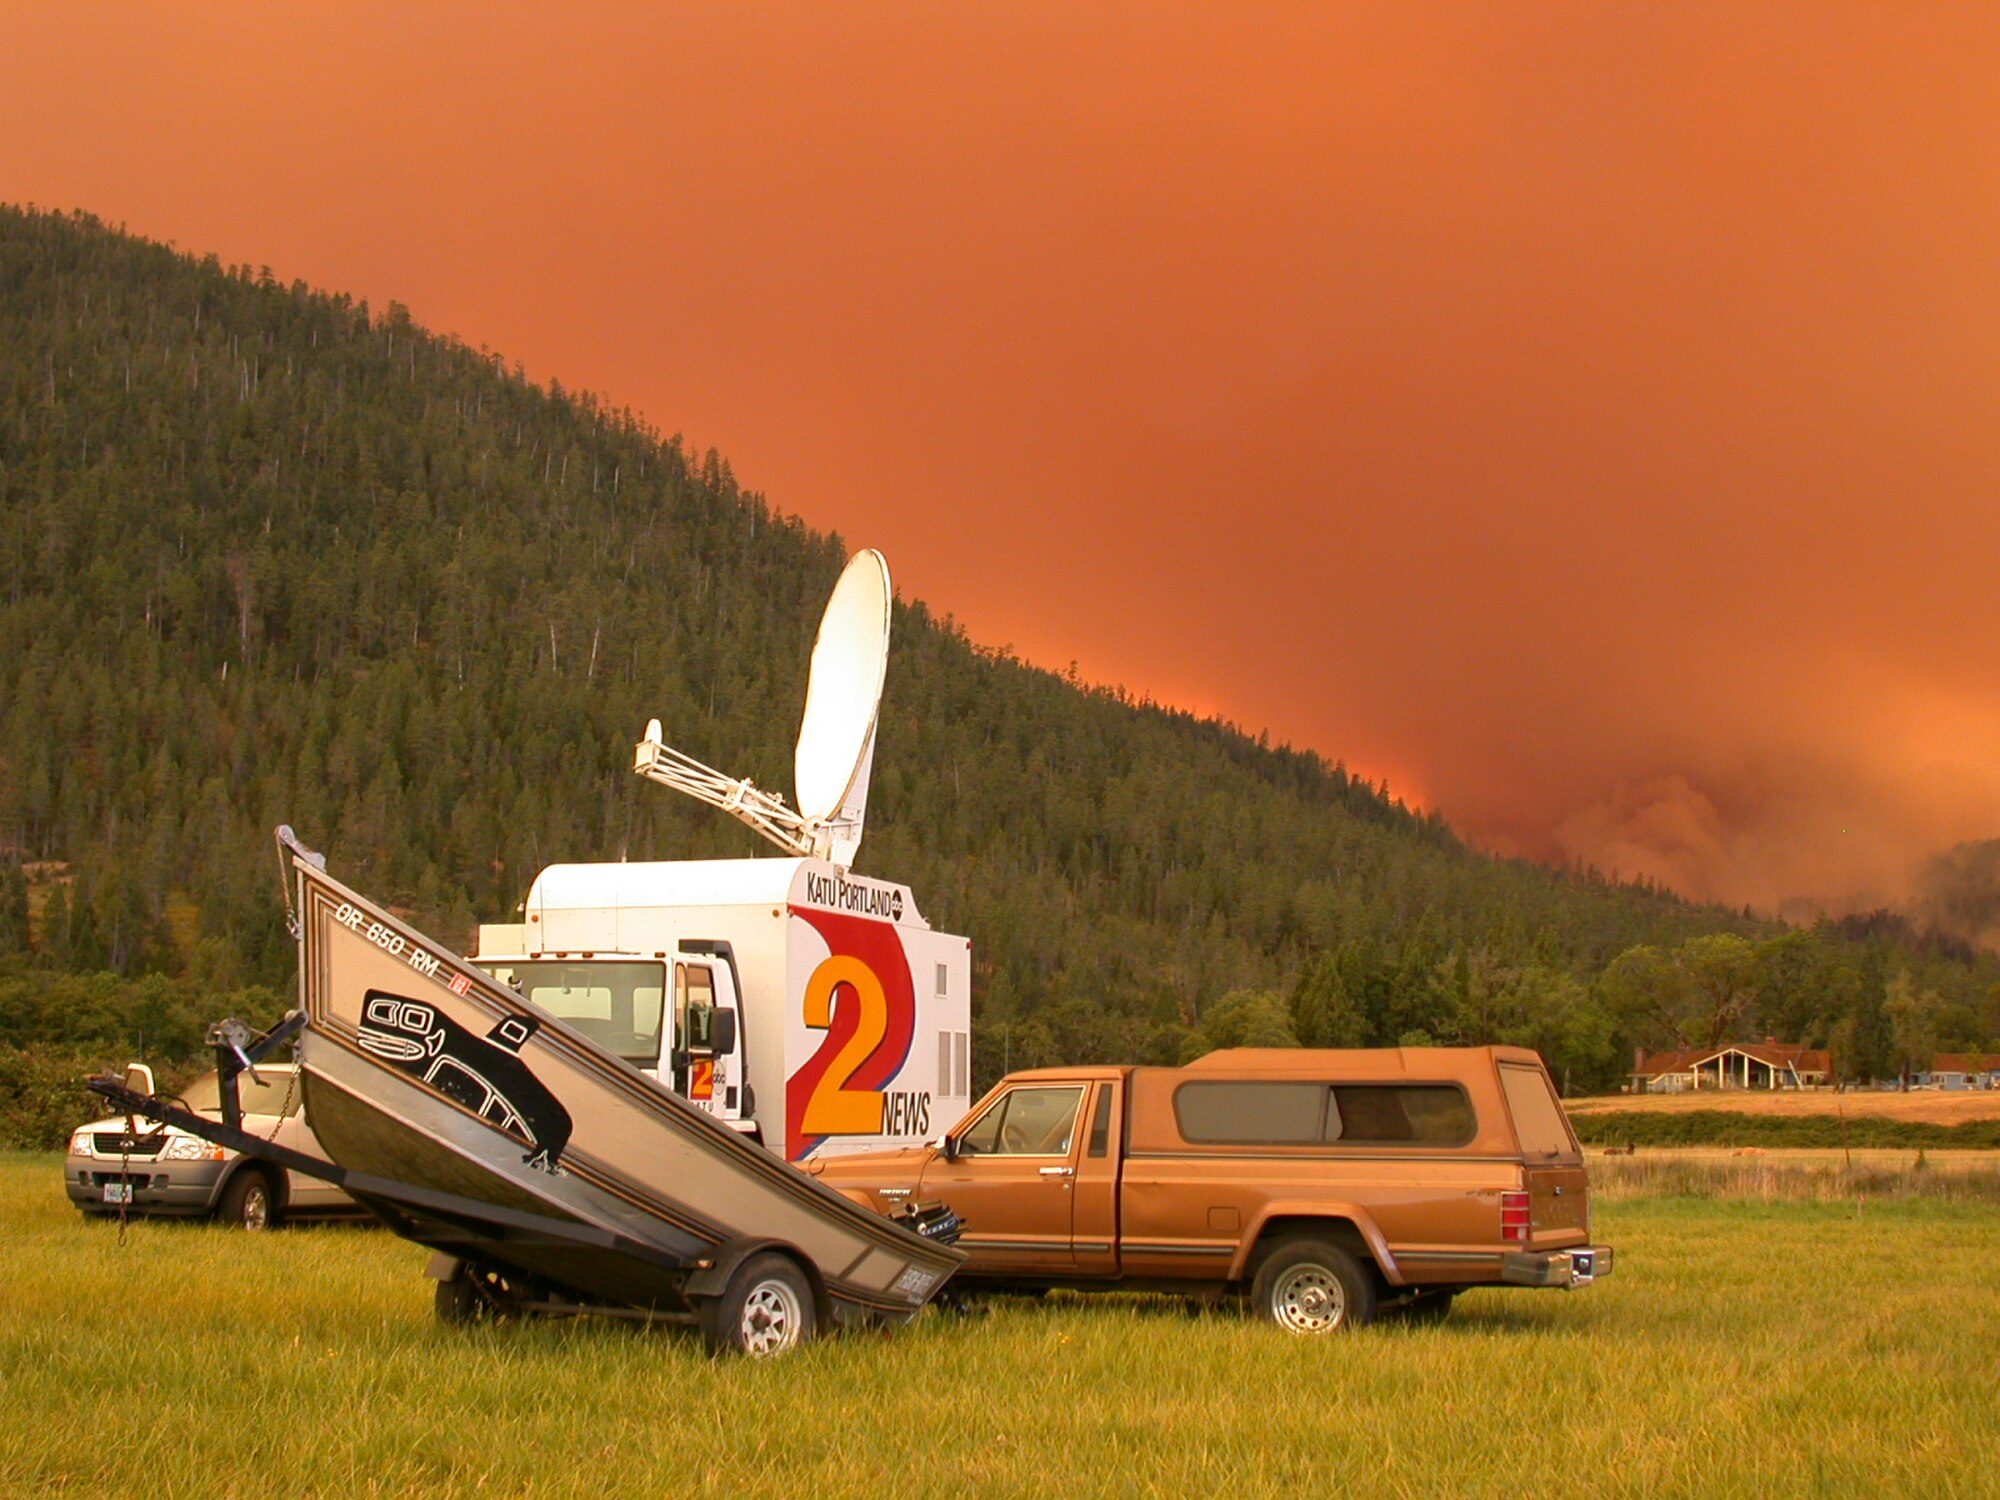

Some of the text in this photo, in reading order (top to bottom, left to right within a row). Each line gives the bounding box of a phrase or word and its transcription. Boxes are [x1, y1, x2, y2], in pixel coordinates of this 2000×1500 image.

[807, 871, 891, 918] KATU PORTLAND
[335, 902, 440, 977] OR 650 RM
[692, 1059, 712, 1094] 2
[801, 955, 888, 1136] 2
[881, 1091, 931, 1137] NEWS
